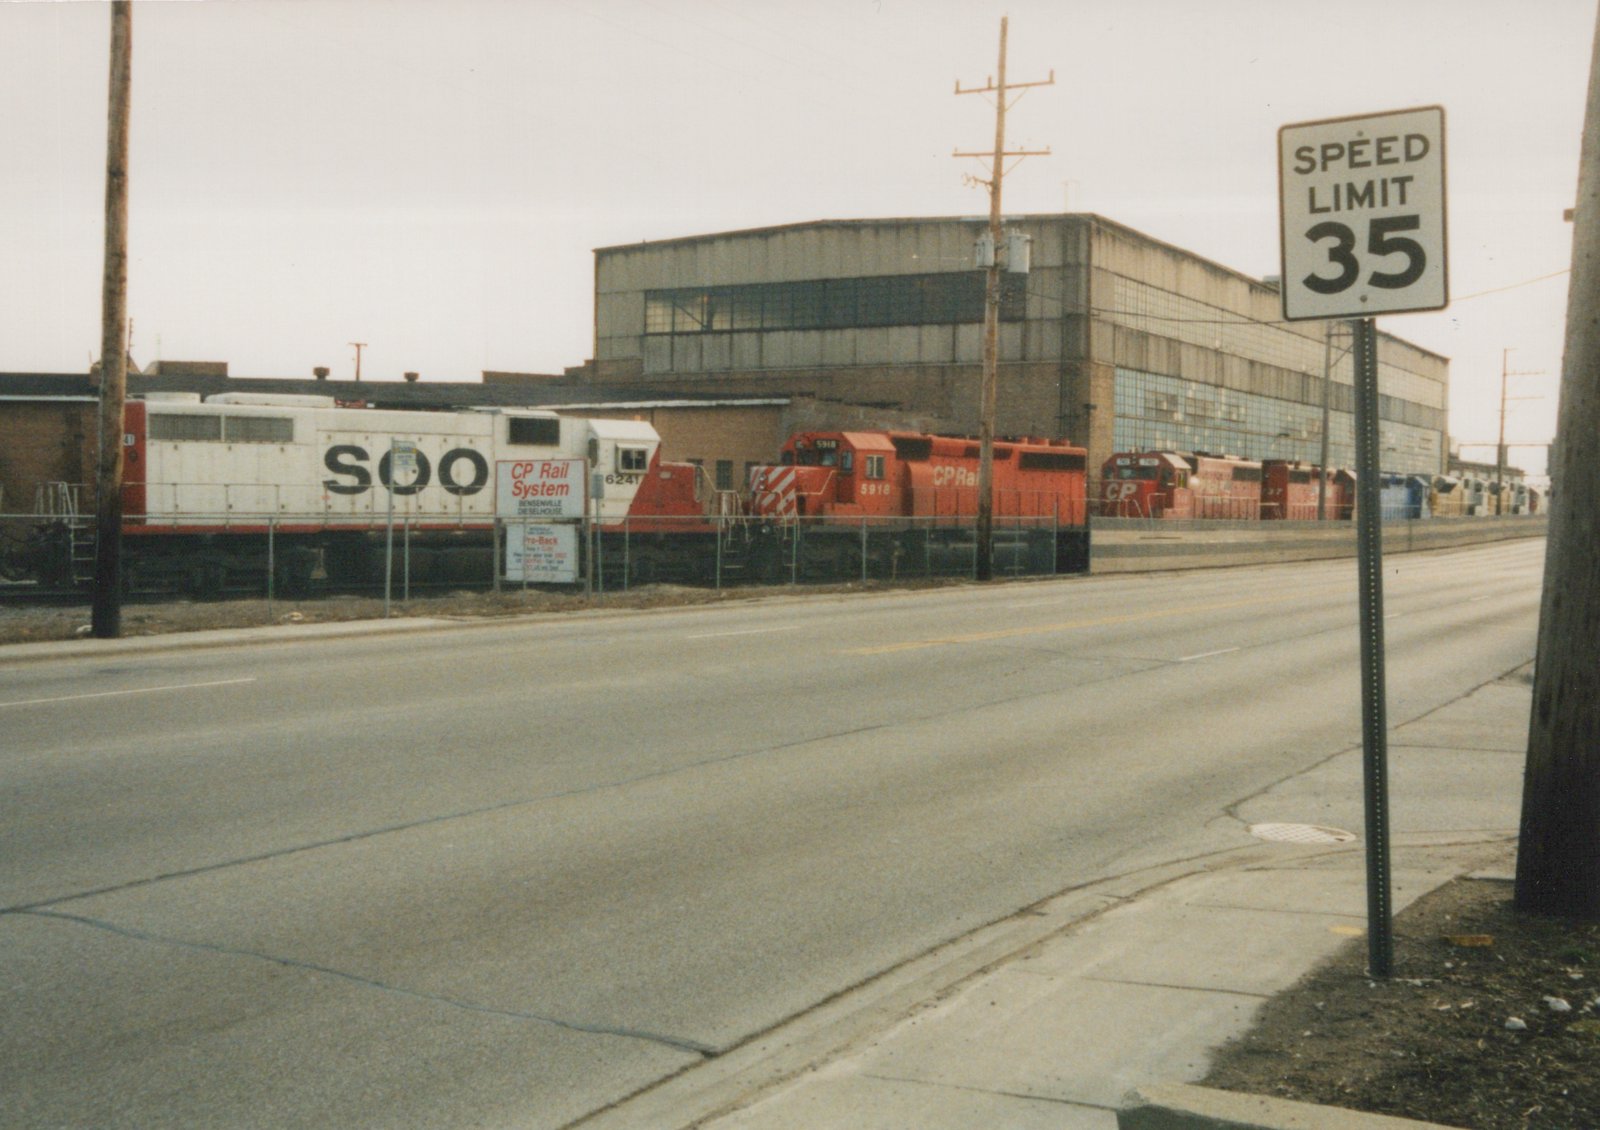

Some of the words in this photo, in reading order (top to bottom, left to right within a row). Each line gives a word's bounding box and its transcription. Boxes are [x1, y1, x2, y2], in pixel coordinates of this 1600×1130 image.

[1293, 133, 1430, 175] SPEED
[1308, 175, 1414, 214] LIMIT
[1302, 214, 1427, 294] 35
[322, 444, 489, 496] SOO
[511, 462, 534, 480] CP
[539, 462, 570, 479] Rail
[605, 473, 639, 485] 6241
[933, 465, 955, 486] CP
[955, 466, 981, 487] Rai
[512, 480, 570, 500] System
[861, 483, 890, 495] 5918
[1106, 483, 1137, 500] CP
